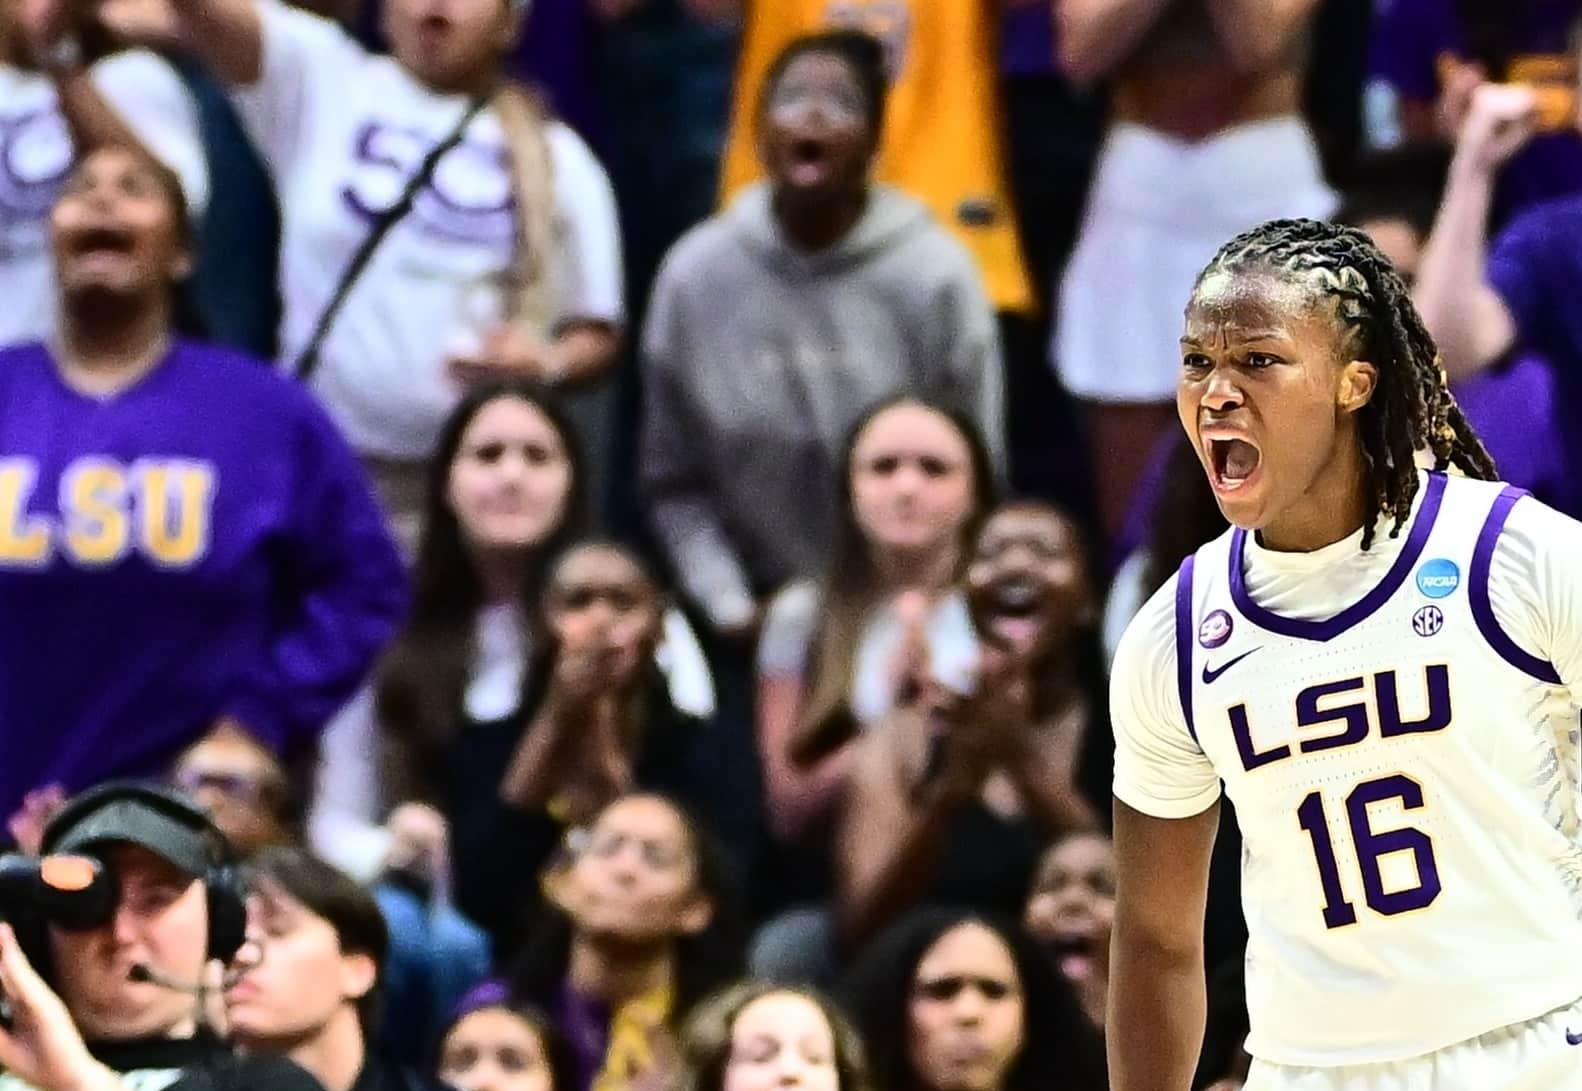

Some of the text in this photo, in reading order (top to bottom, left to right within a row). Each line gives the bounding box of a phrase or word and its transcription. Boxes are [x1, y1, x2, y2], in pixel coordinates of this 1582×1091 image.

[0, 456, 218, 570] LSU
[1413, 606, 1443, 636] SEC
[1421, 575, 1458, 588] NCAA
[1227, 663, 1453, 772] LSU
[1296, 773, 1443, 930] 16
